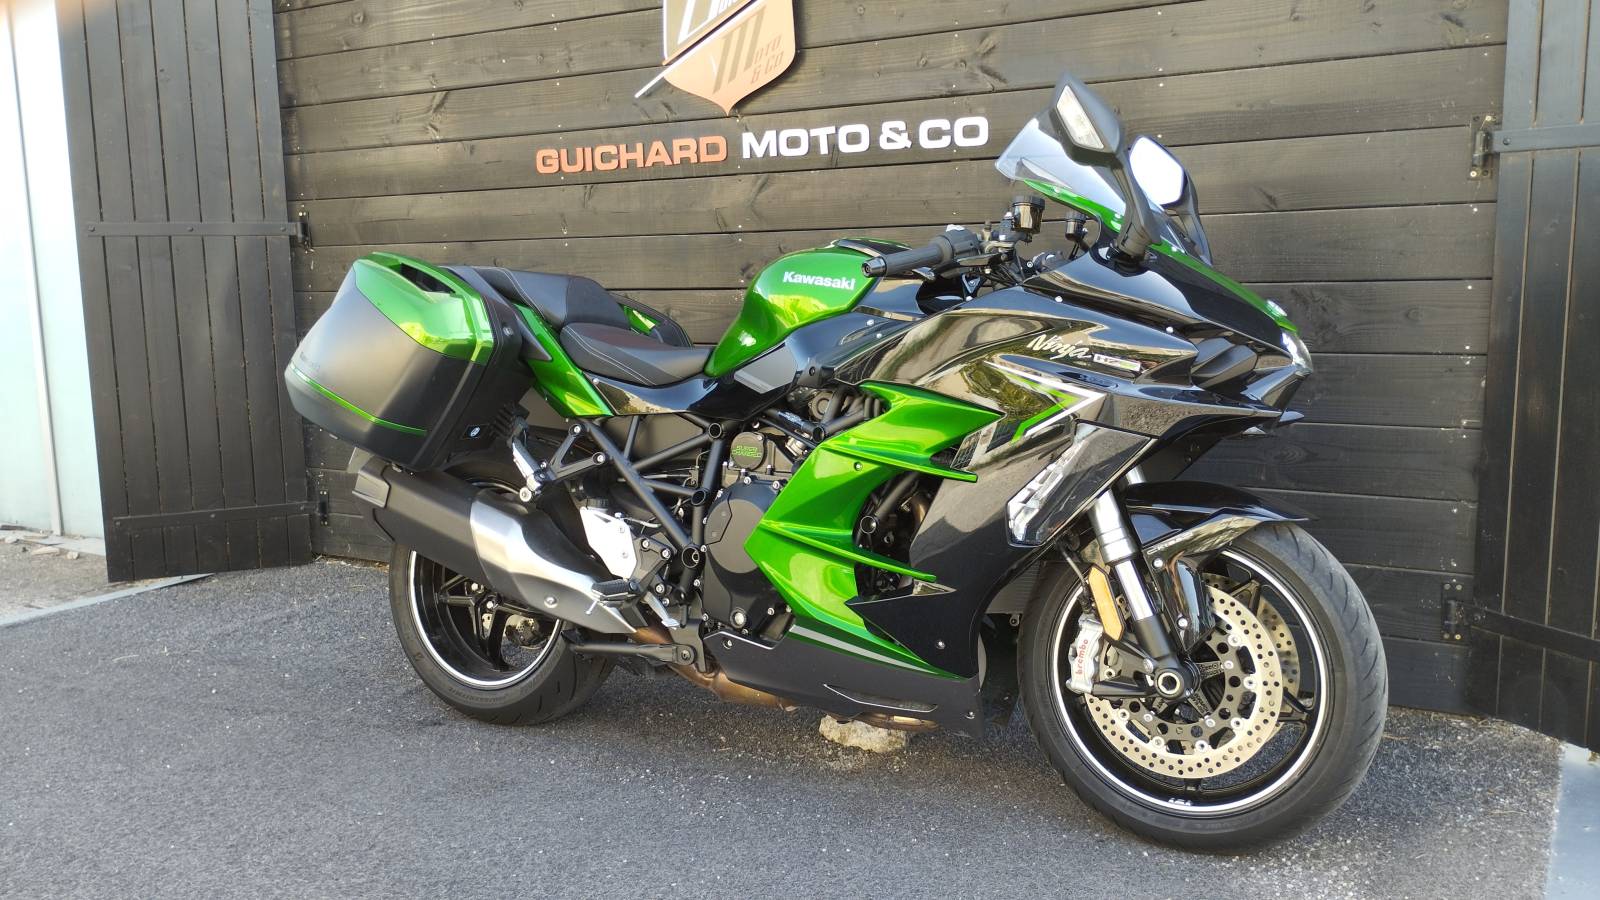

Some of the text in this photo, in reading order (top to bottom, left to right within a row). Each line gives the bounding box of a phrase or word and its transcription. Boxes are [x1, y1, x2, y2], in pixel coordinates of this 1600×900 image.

[536, 116, 989, 174] GUICHARD MOTO & CO
[782, 271, 856, 291] Kawasaki
[1026, 333, 1092, 360] Ninja
[1075, 639, 1089, 675] brembo
